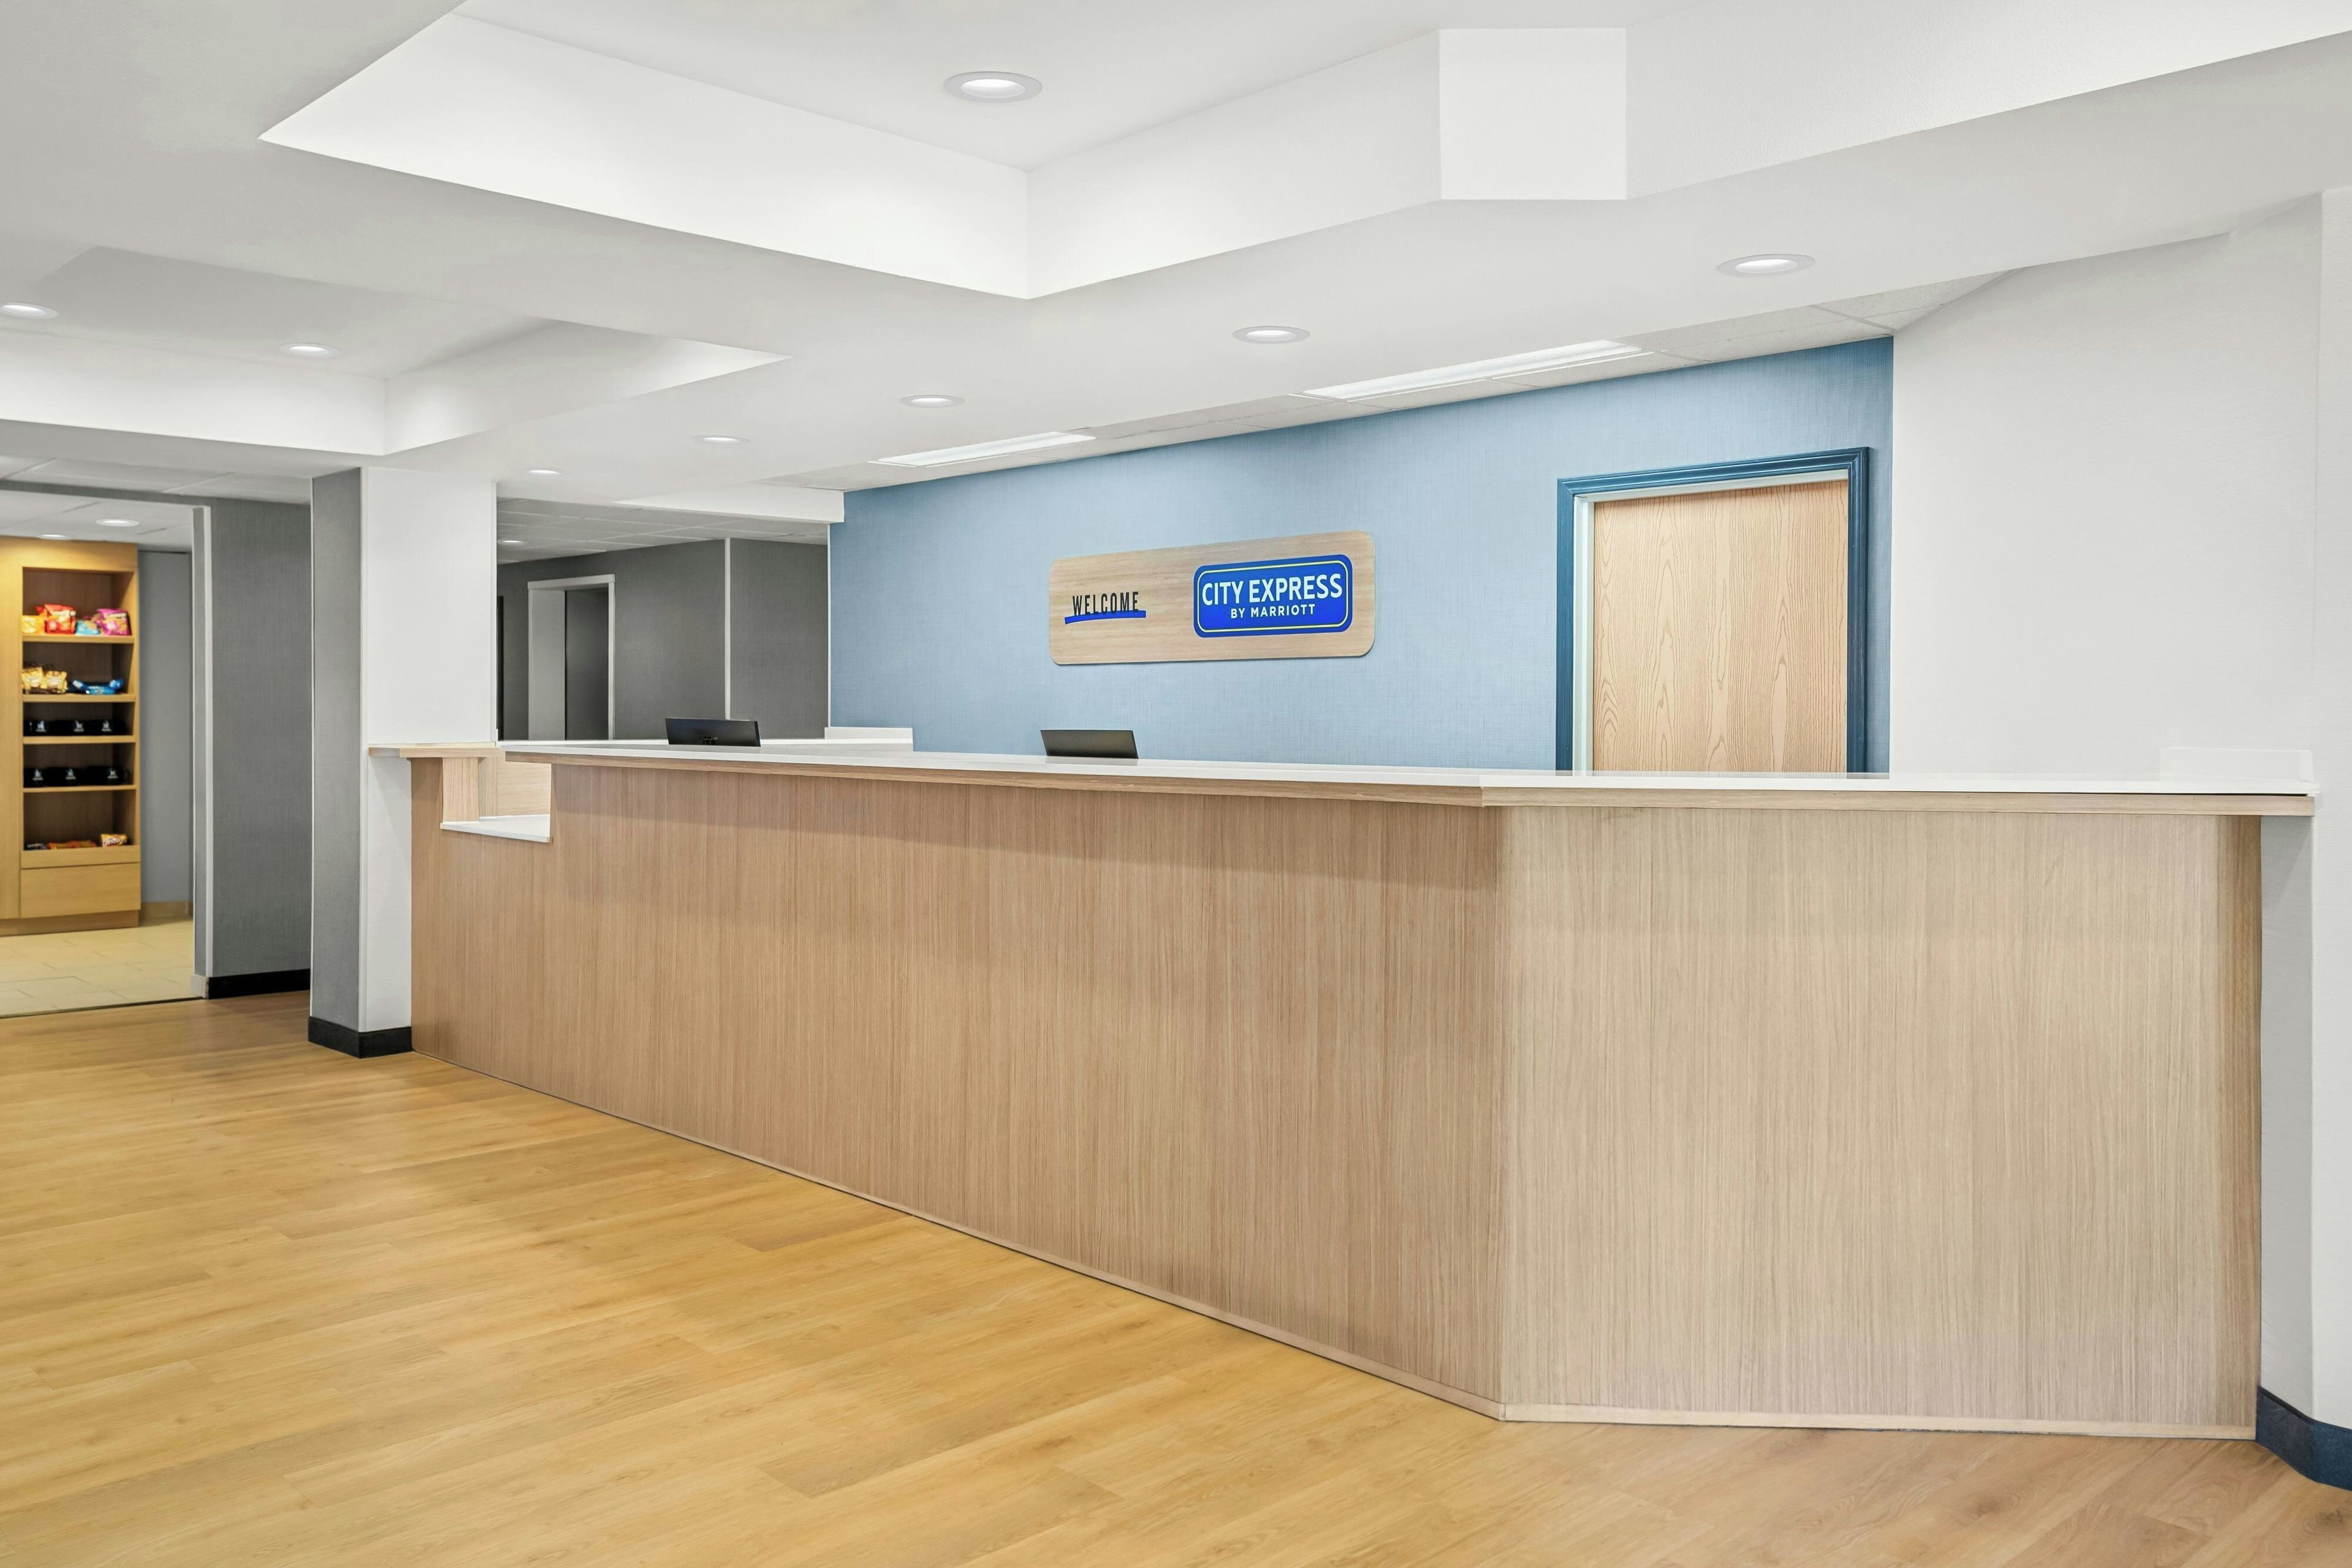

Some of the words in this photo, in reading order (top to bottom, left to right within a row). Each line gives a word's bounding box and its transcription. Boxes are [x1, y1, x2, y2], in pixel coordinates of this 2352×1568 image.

[1202, 580, 1244, 606] CITY
[1248, 573, 1343, 603] EXPRESS
[1072, 591, 1139, 616] WELCOME
[1231, 608, 1245, 619] BY
[1251, 604, 1315, 618] MARRIOTT
